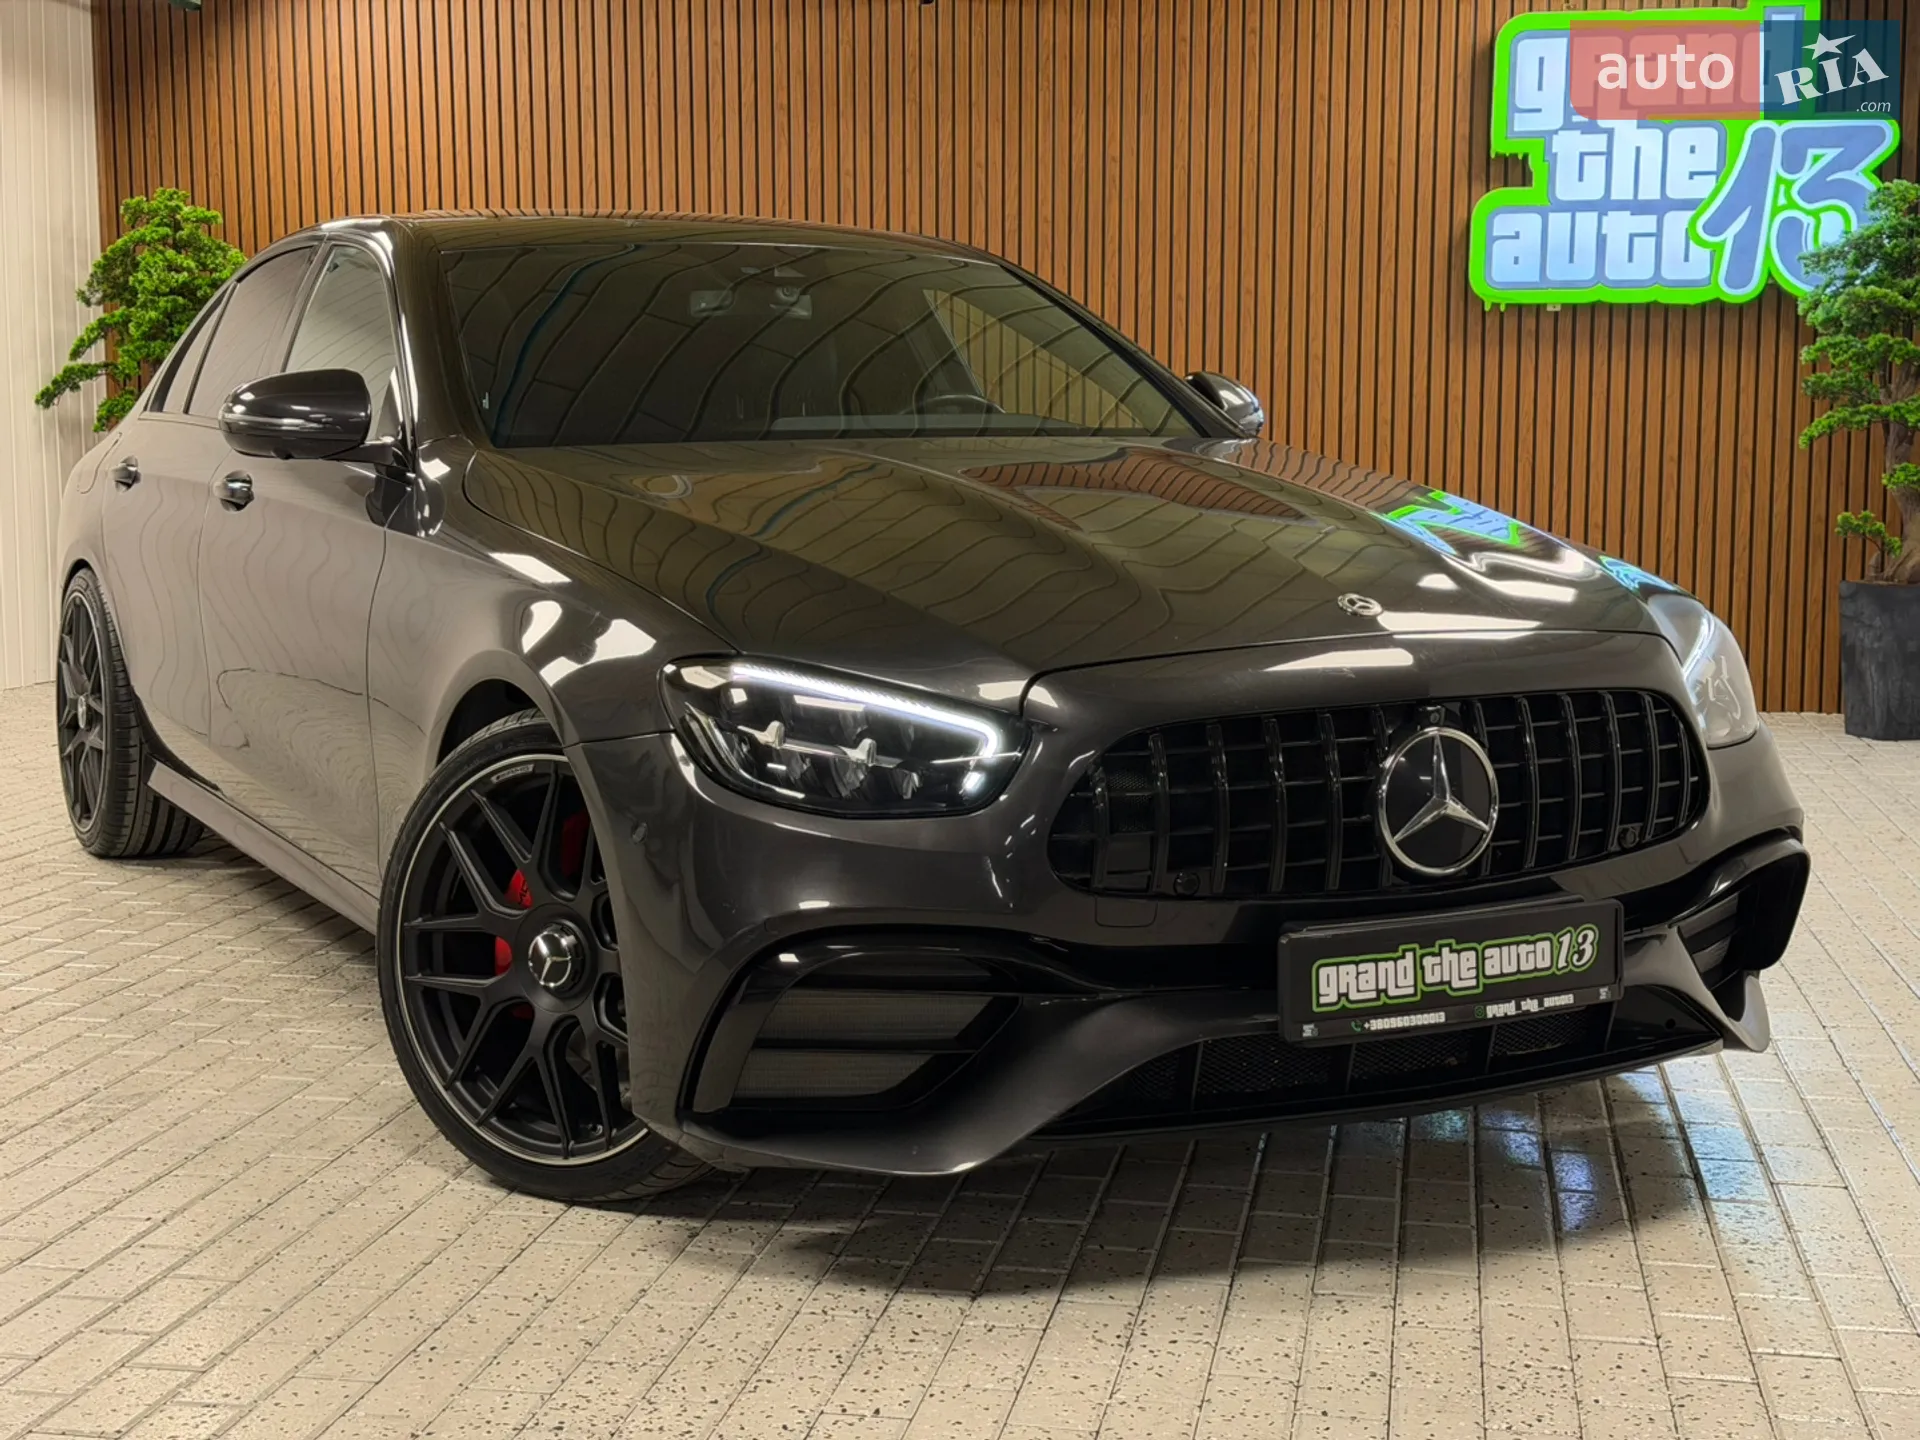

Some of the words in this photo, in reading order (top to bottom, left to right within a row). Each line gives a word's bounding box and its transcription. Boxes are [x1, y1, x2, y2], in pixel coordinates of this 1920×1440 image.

[1552, 112, 1719, 200] the
[1490, 210, 1714, 283] auto
[1697, 120, 1892, 296] 13
[1318, 952, 1415, 1004] grand
[1423, 946, 1477, 988] the
